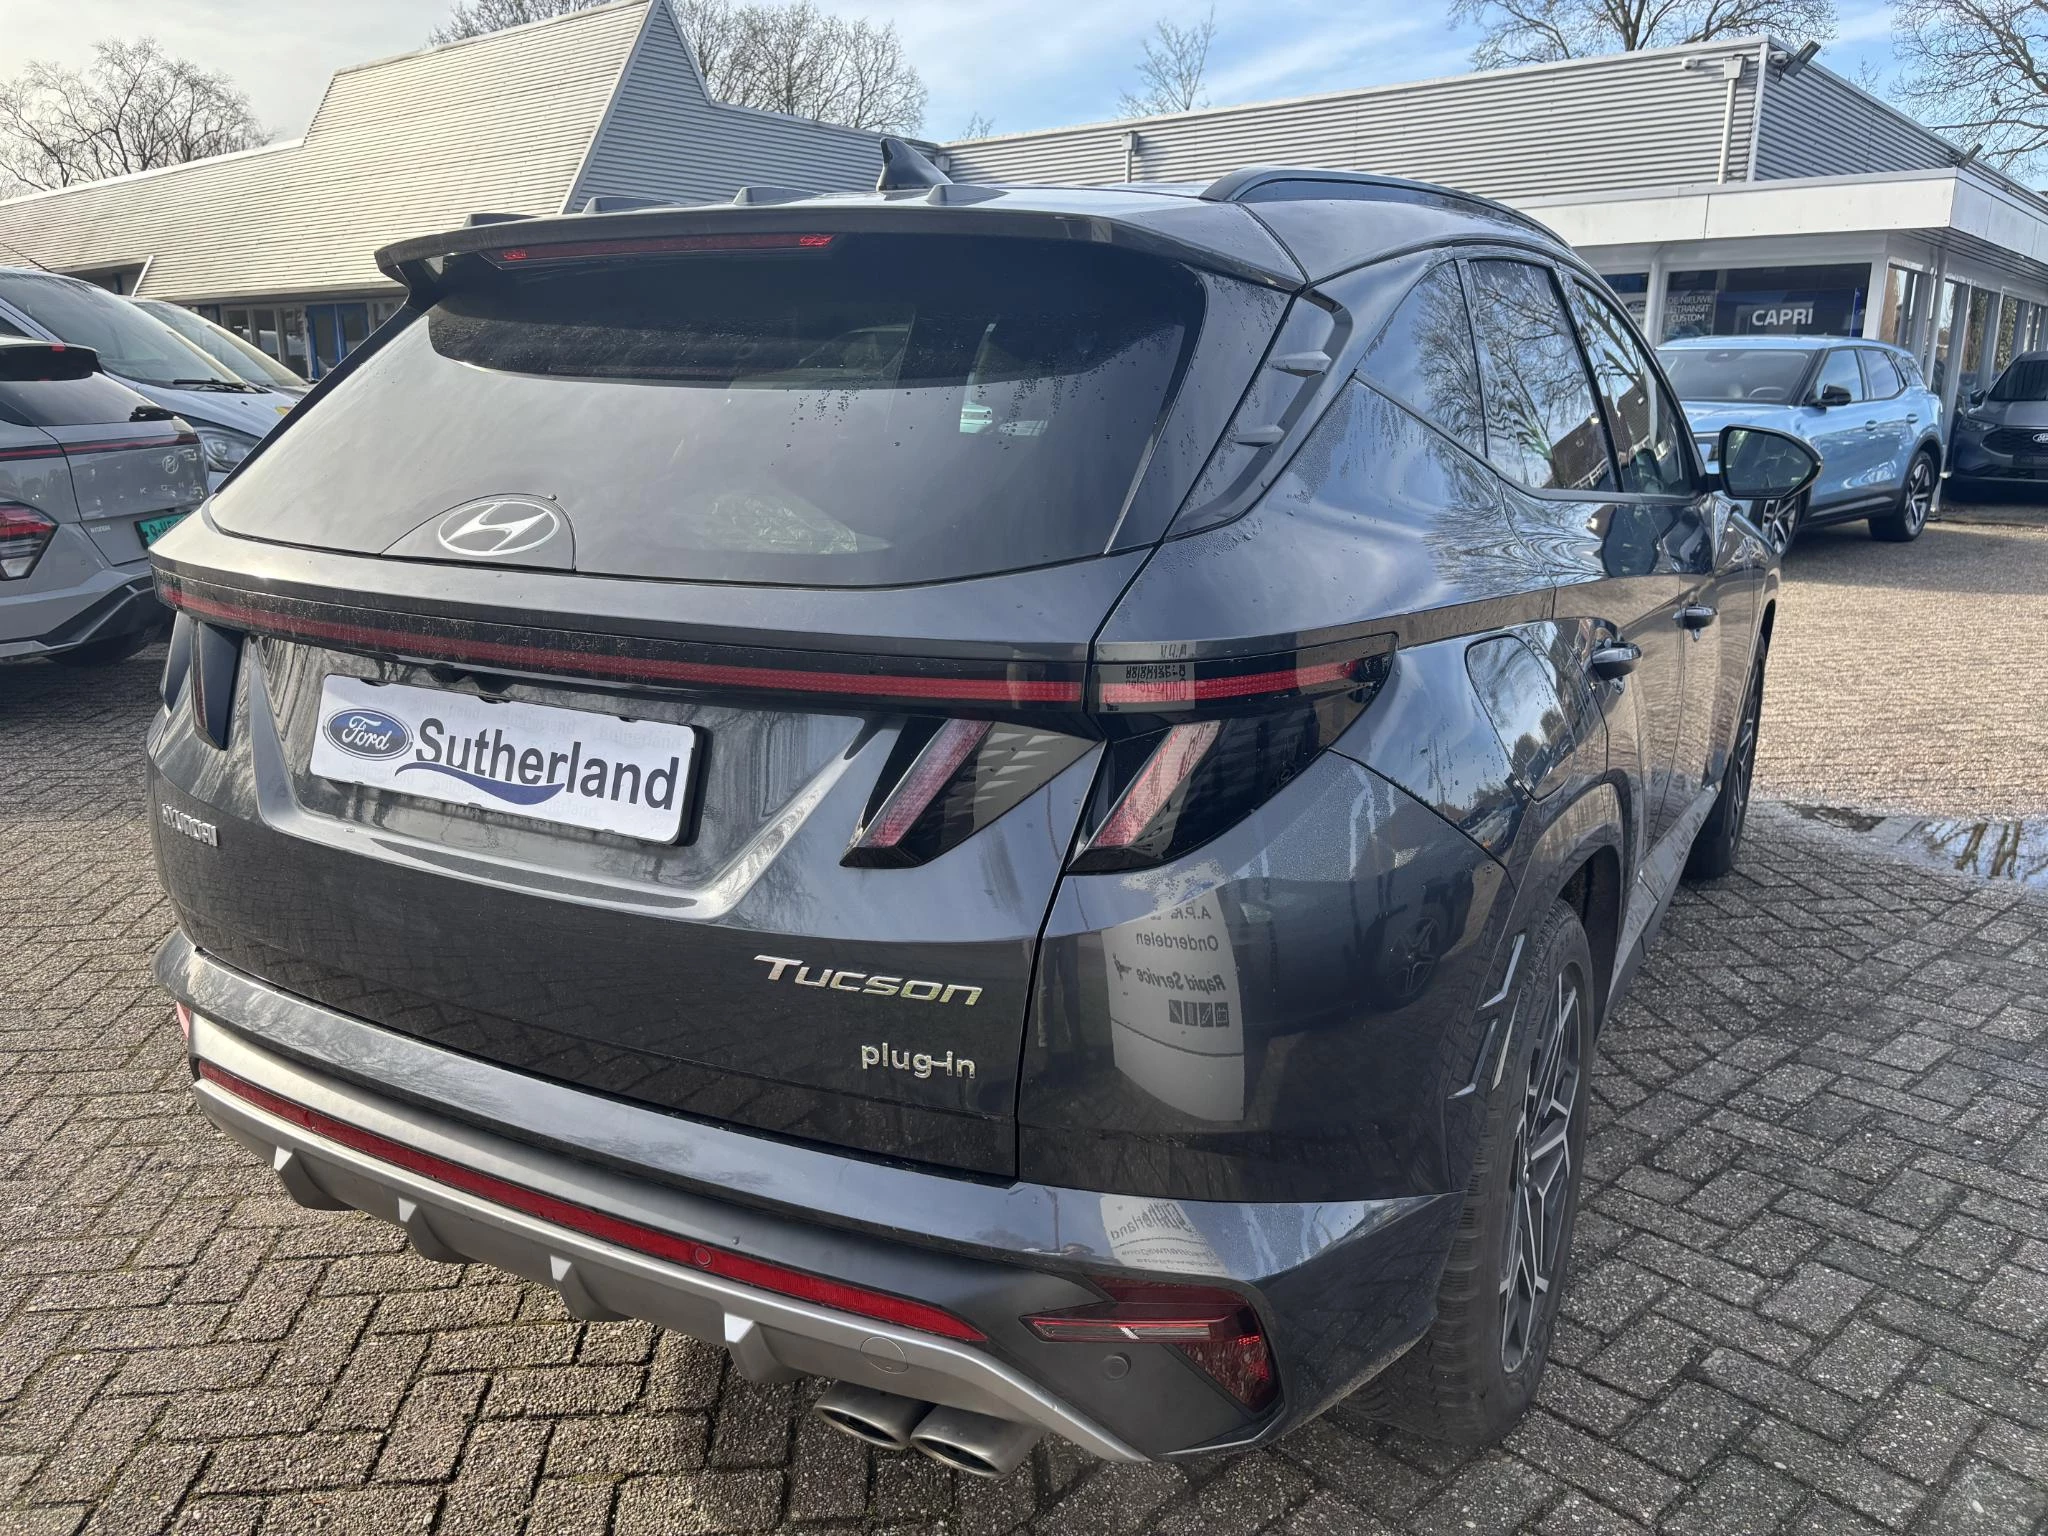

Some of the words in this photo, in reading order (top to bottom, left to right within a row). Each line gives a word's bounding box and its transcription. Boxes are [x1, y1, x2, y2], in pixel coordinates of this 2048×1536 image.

[1671, 313, 1705, 323] CUSTOM
[1752, 308, 1814, 327] CAPRI
[341, 714, 392, 752] Ford
[415, 717, 681, 811] Sutherland
[861, 1042, 976, 1079] plug-in
